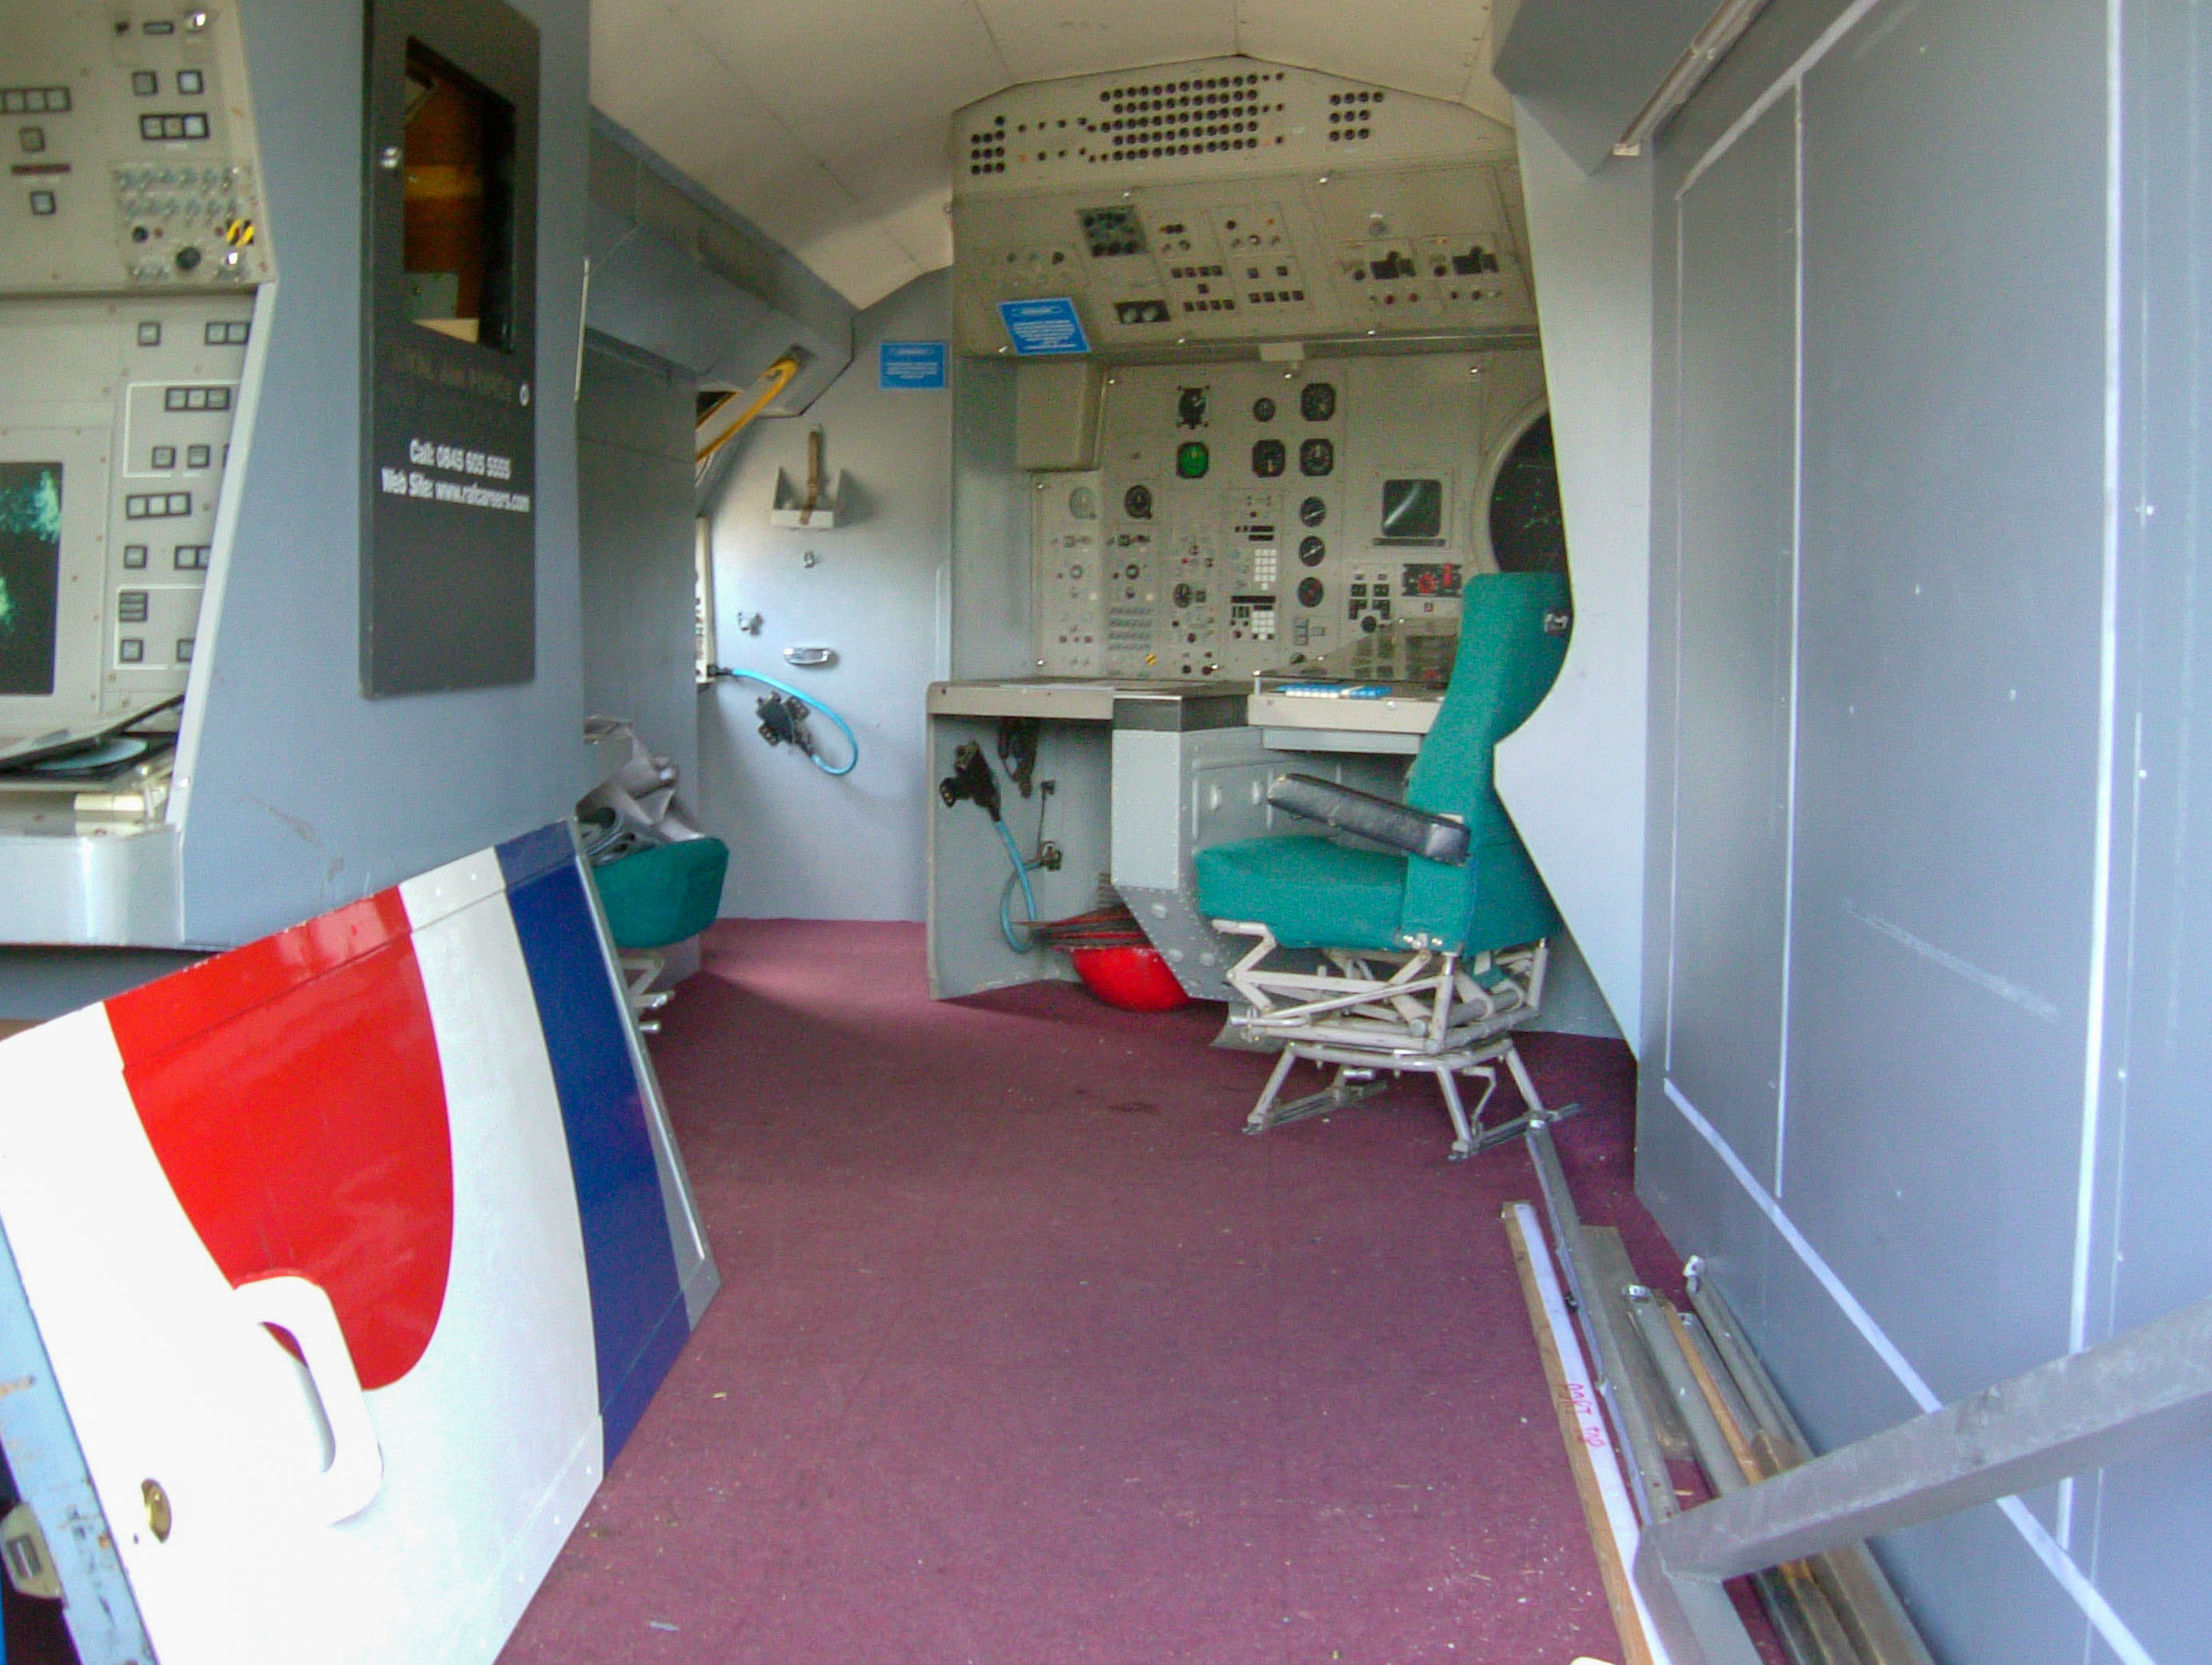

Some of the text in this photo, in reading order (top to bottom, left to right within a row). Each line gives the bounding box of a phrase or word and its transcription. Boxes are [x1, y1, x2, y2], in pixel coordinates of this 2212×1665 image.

[436, 444, 464, 472] 0845
[465, 451, 486, 476] 605
[487, 455, 512, 480] 5555
[381, 467, 408, 495] Web
[434, 481, 531, 512] www.rafcareers.com
